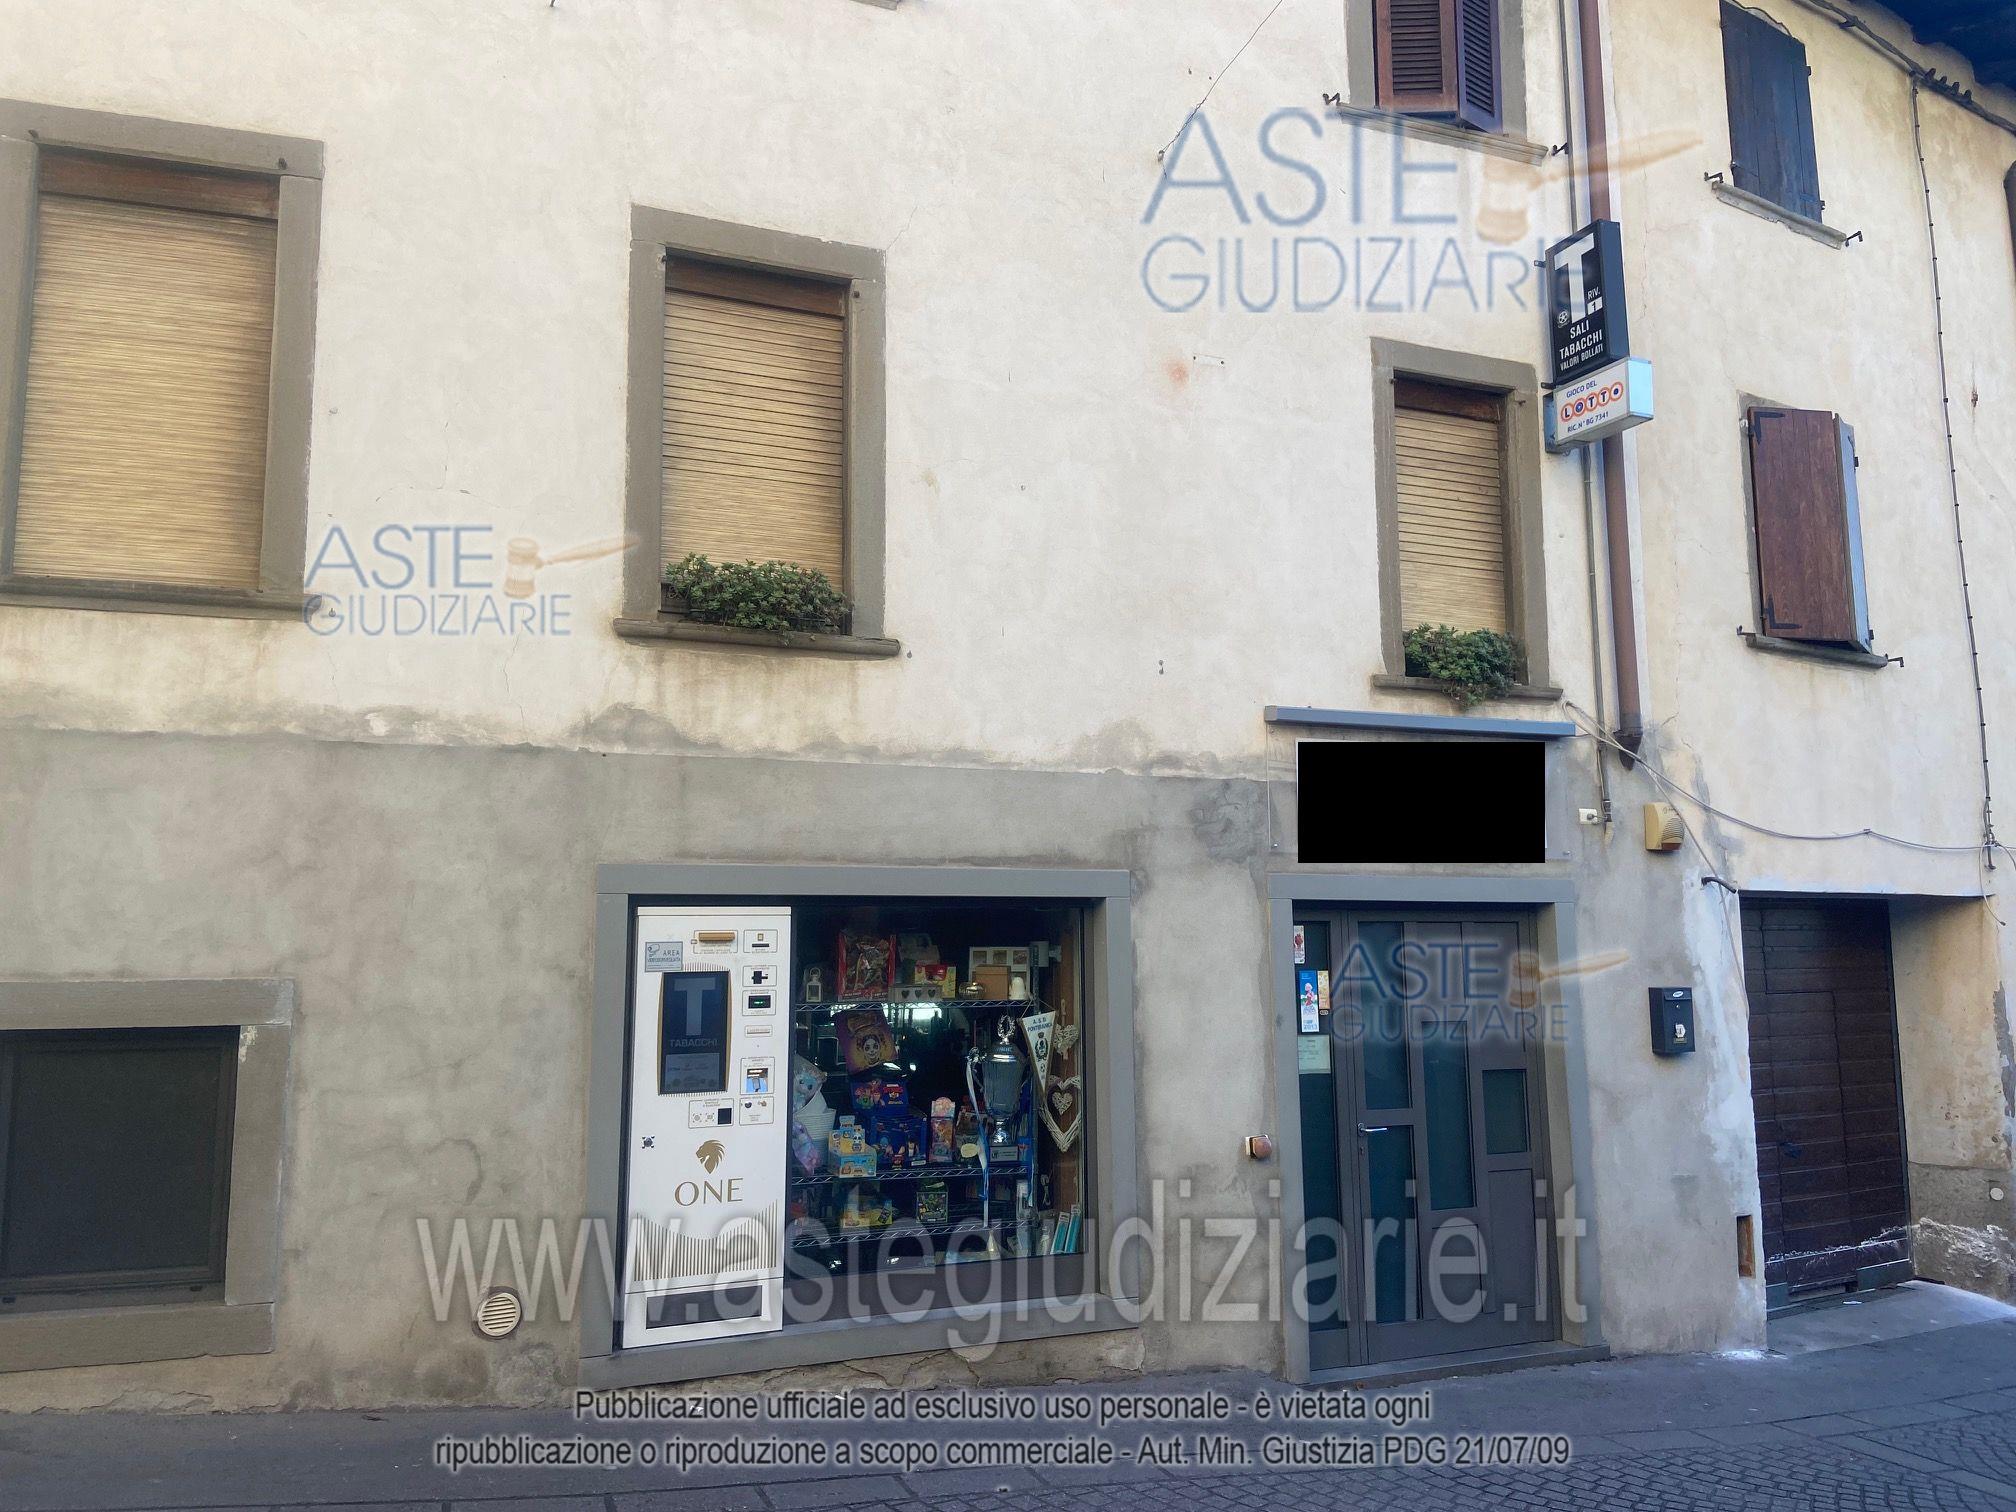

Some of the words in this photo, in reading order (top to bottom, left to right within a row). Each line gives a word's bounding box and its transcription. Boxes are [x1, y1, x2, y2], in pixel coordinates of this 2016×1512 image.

[1554, 232, 1595, 324] T
[1587, 286, 1601, 300] RIV.
[1569, 320, 1590, 339] SALI
[1559, 329, 1603, 360] TABACCHI
[1560, 358, 1580, 371] VALORI
[1581, 343, 1604, 361] BOLLATI
[1561, 382, 1624, 422] LOTTO
[1566, 386, 1585, 399] GIOCO
[1586, 380, 1598, 390] DEL
[1595, 410, 1609, 421] 7341
[674, 978, 716, 1036] T
[669, 1038, 718, 1048] TABACCHI
[674, 1178, 743, 1206] ONE
